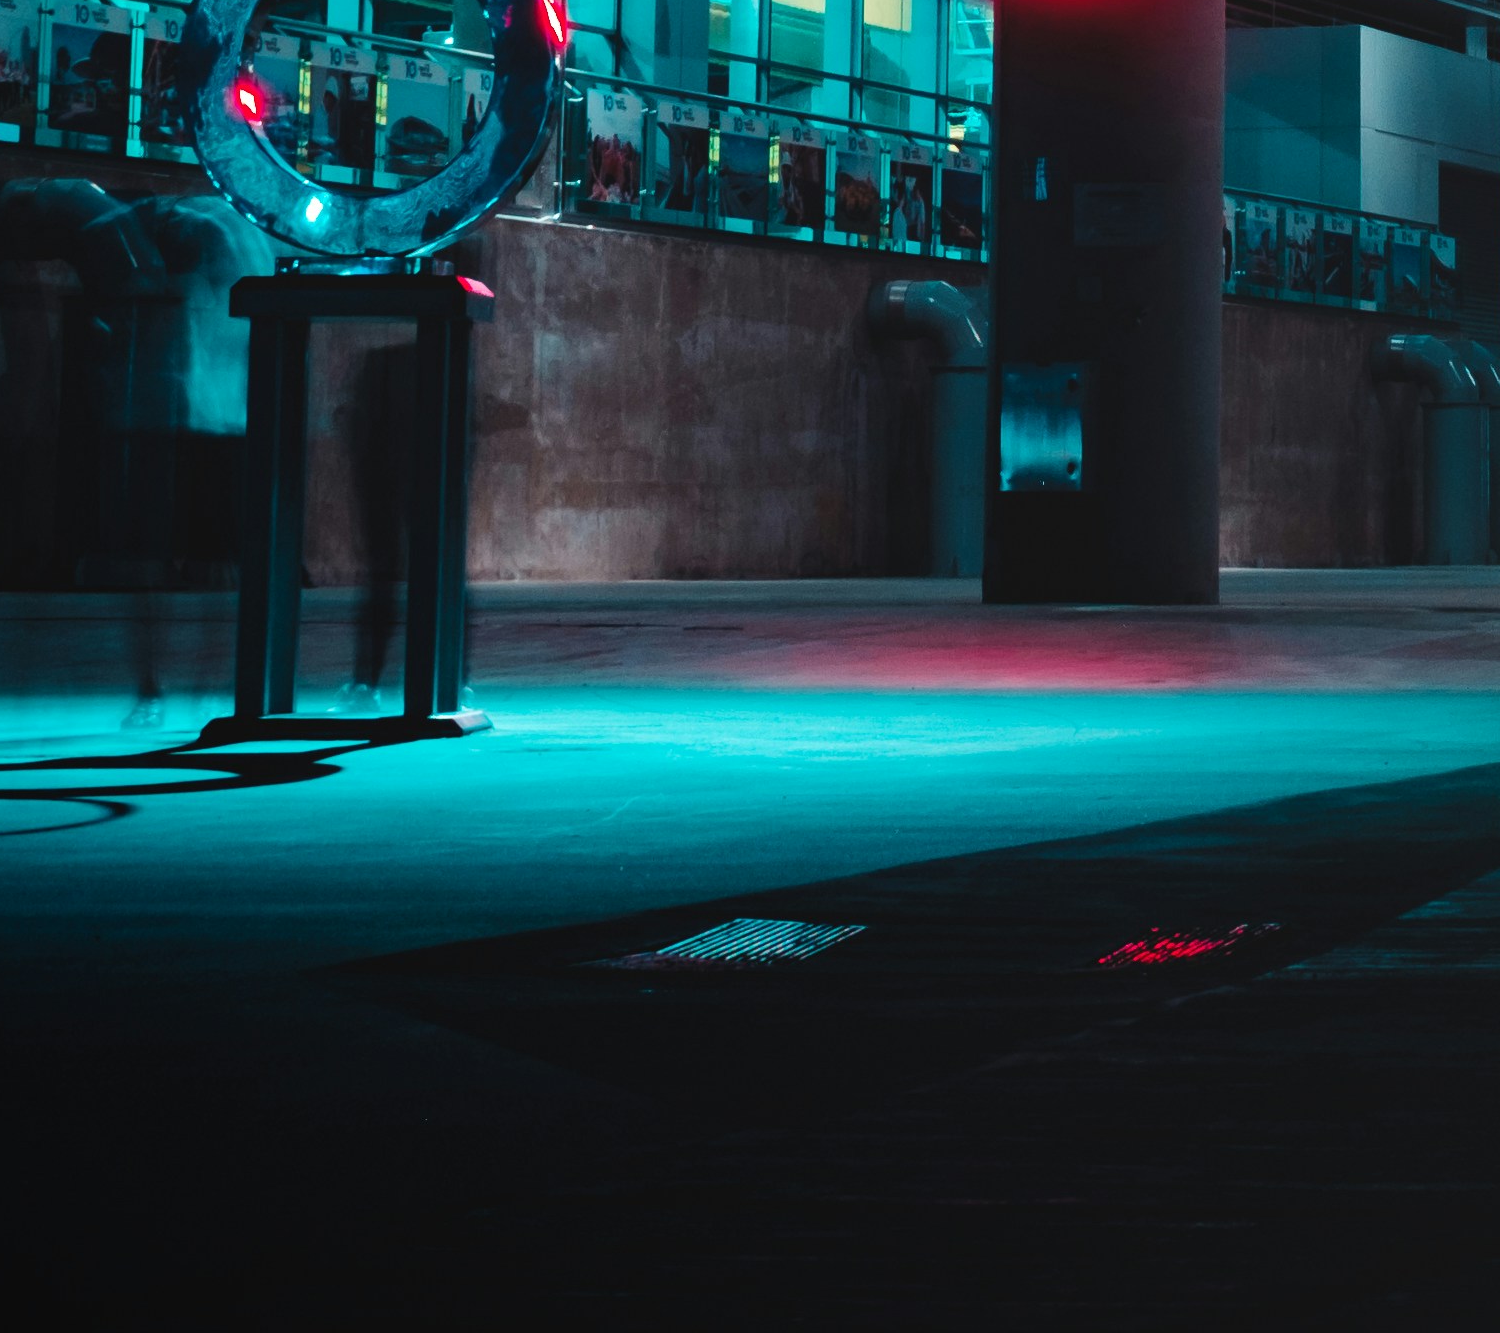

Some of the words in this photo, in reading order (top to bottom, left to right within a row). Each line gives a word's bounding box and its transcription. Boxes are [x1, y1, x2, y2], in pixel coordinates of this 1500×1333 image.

[75, 3, 89, 24] 10
[165, 19, 179, 39] 10
[329, 46, 343, 66] 10
[405, 59, 417, 79] 10
